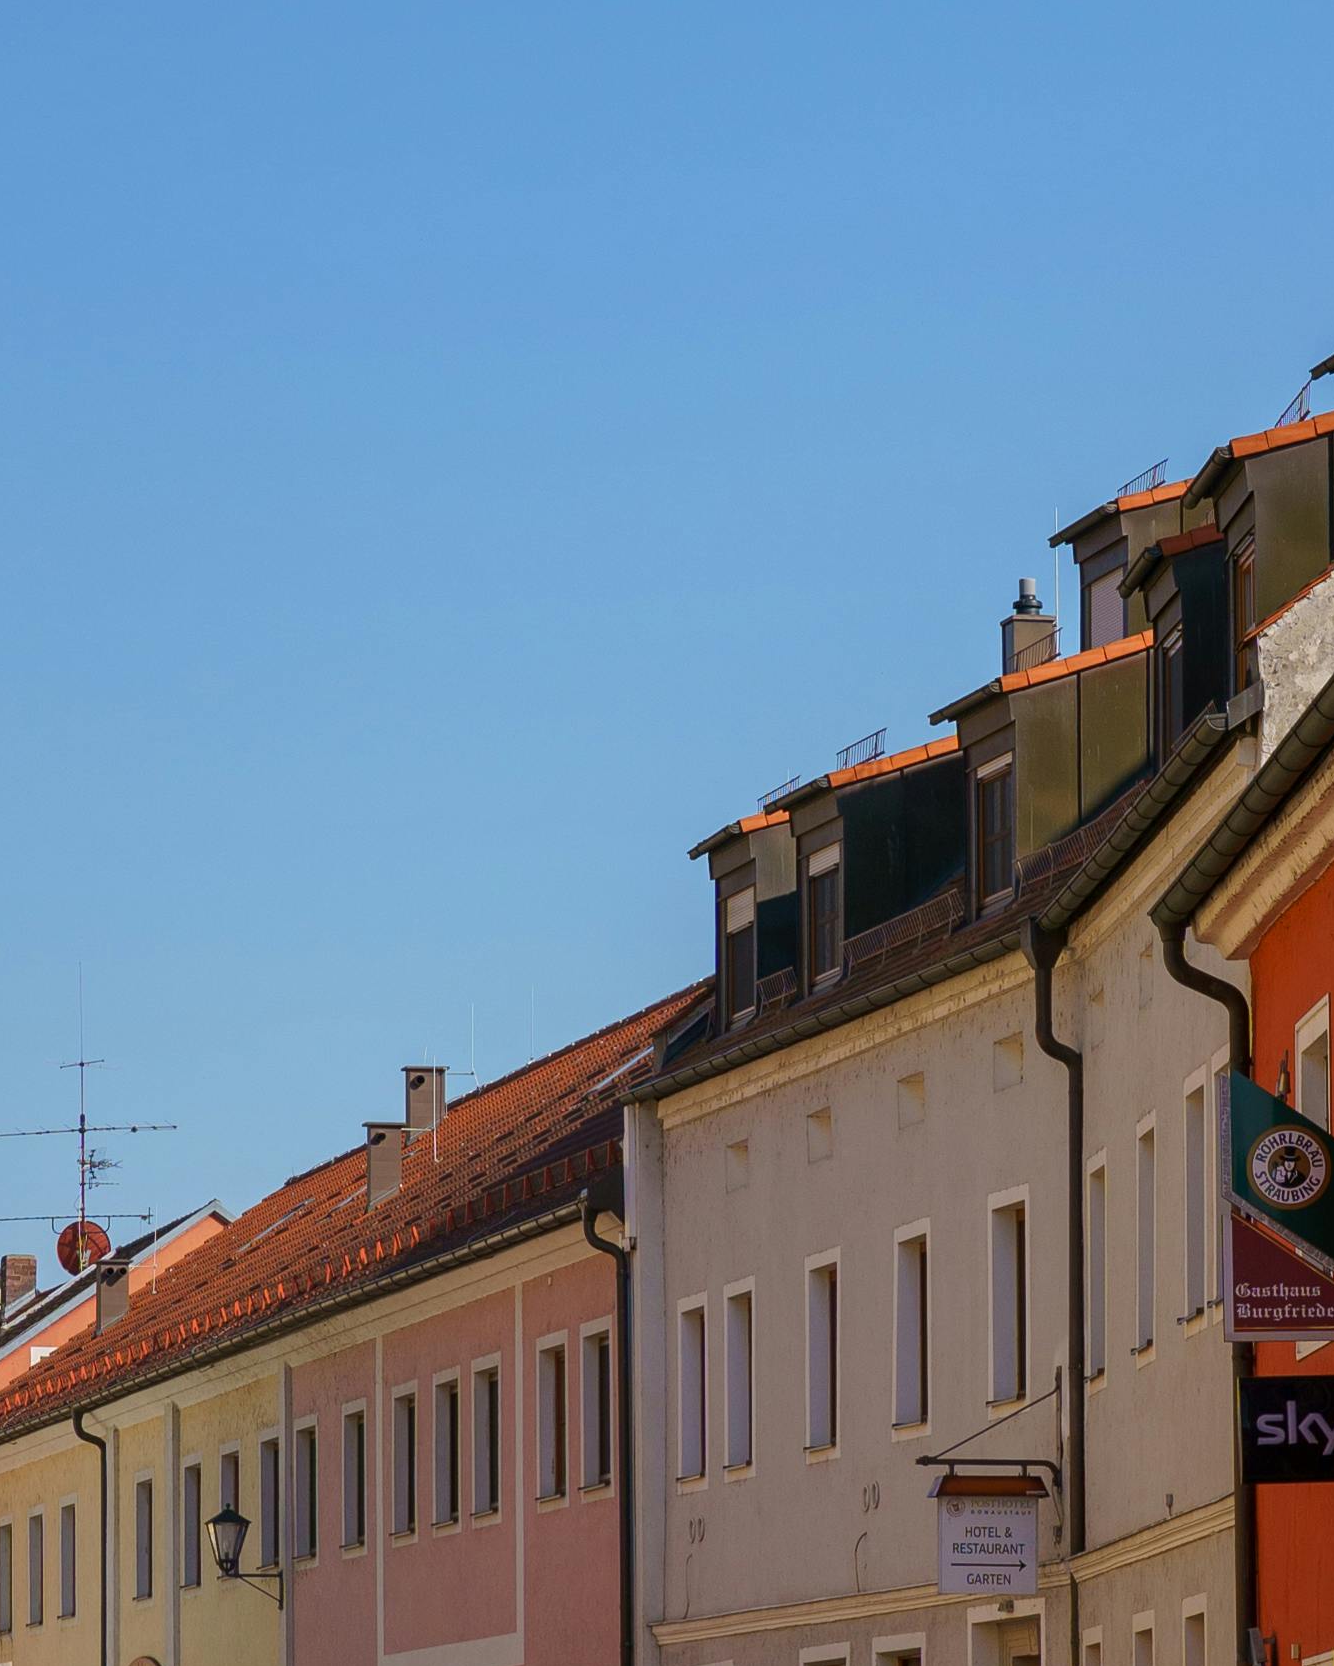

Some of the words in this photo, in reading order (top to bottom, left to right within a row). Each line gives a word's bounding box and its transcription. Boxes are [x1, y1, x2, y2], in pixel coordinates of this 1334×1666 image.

[1255, 1132, 1324, 1168] RÖHRLBRÄU
[1254, 1170, 1321, 1203] STRAUBING
[1235, 1282, 1322, 1301] Gasthaus
[965, 1526, 1001, 1538] HOTEL
[1004, 1526, 1013, 1538] &
[952, 1542, 1026, 1555] RESTAURANT
[966, 1573, 1011, 1585] GARTEN
